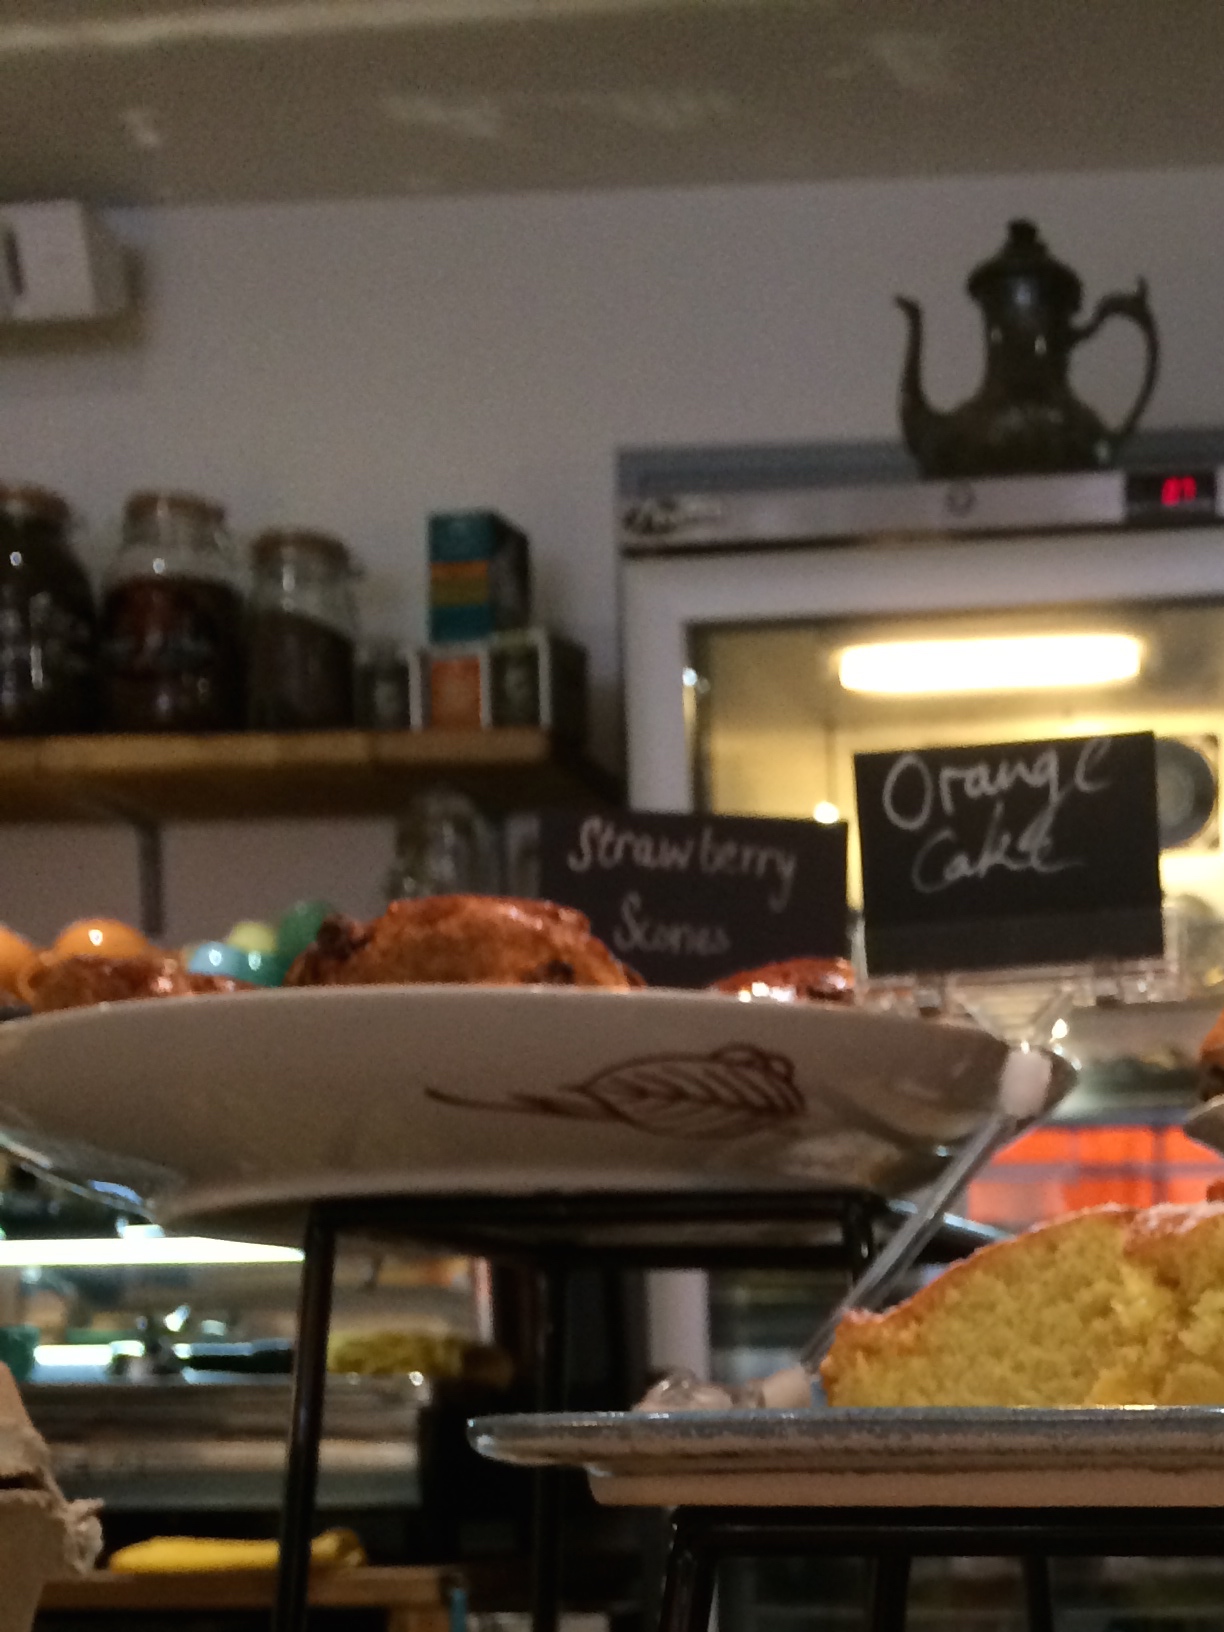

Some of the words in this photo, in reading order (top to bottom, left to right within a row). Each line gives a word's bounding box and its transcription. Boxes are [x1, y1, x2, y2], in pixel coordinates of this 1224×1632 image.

[881, 735, 1114, 848] Orange
[566, 814, 798, 915] Strawberry
[911, 800, 1087, 895] Cake
